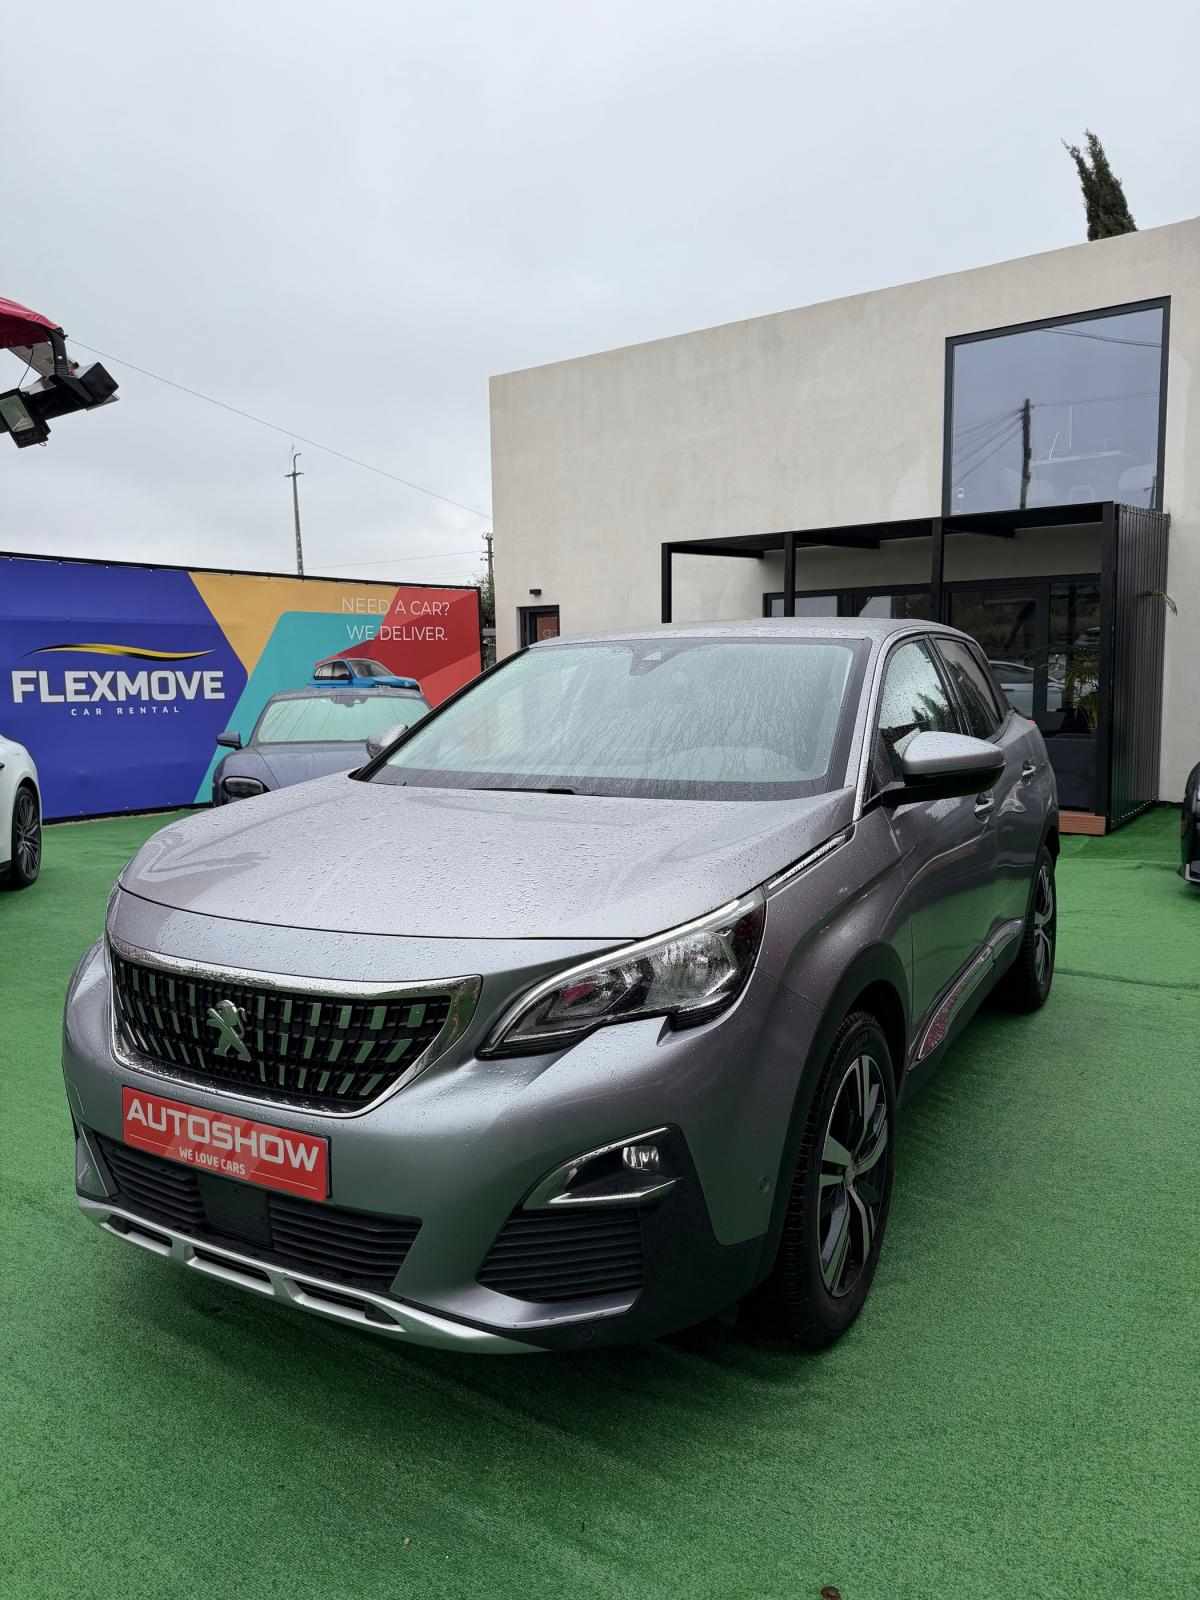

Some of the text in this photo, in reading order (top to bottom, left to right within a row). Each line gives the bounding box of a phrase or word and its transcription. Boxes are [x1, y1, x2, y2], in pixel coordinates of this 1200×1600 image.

[341, 598, 450, 616] NEED A CAR?
[346, 623, 448, 641] WE DELIVER.
[11, 670, 225, 704] FLEXMOVE
[71, 706, 180, 716] CAR RENTAL
[126, 1098, 319, 1172] AUTOSHOW
[178, 1147, 246, 1175] WE LOVE CARS
